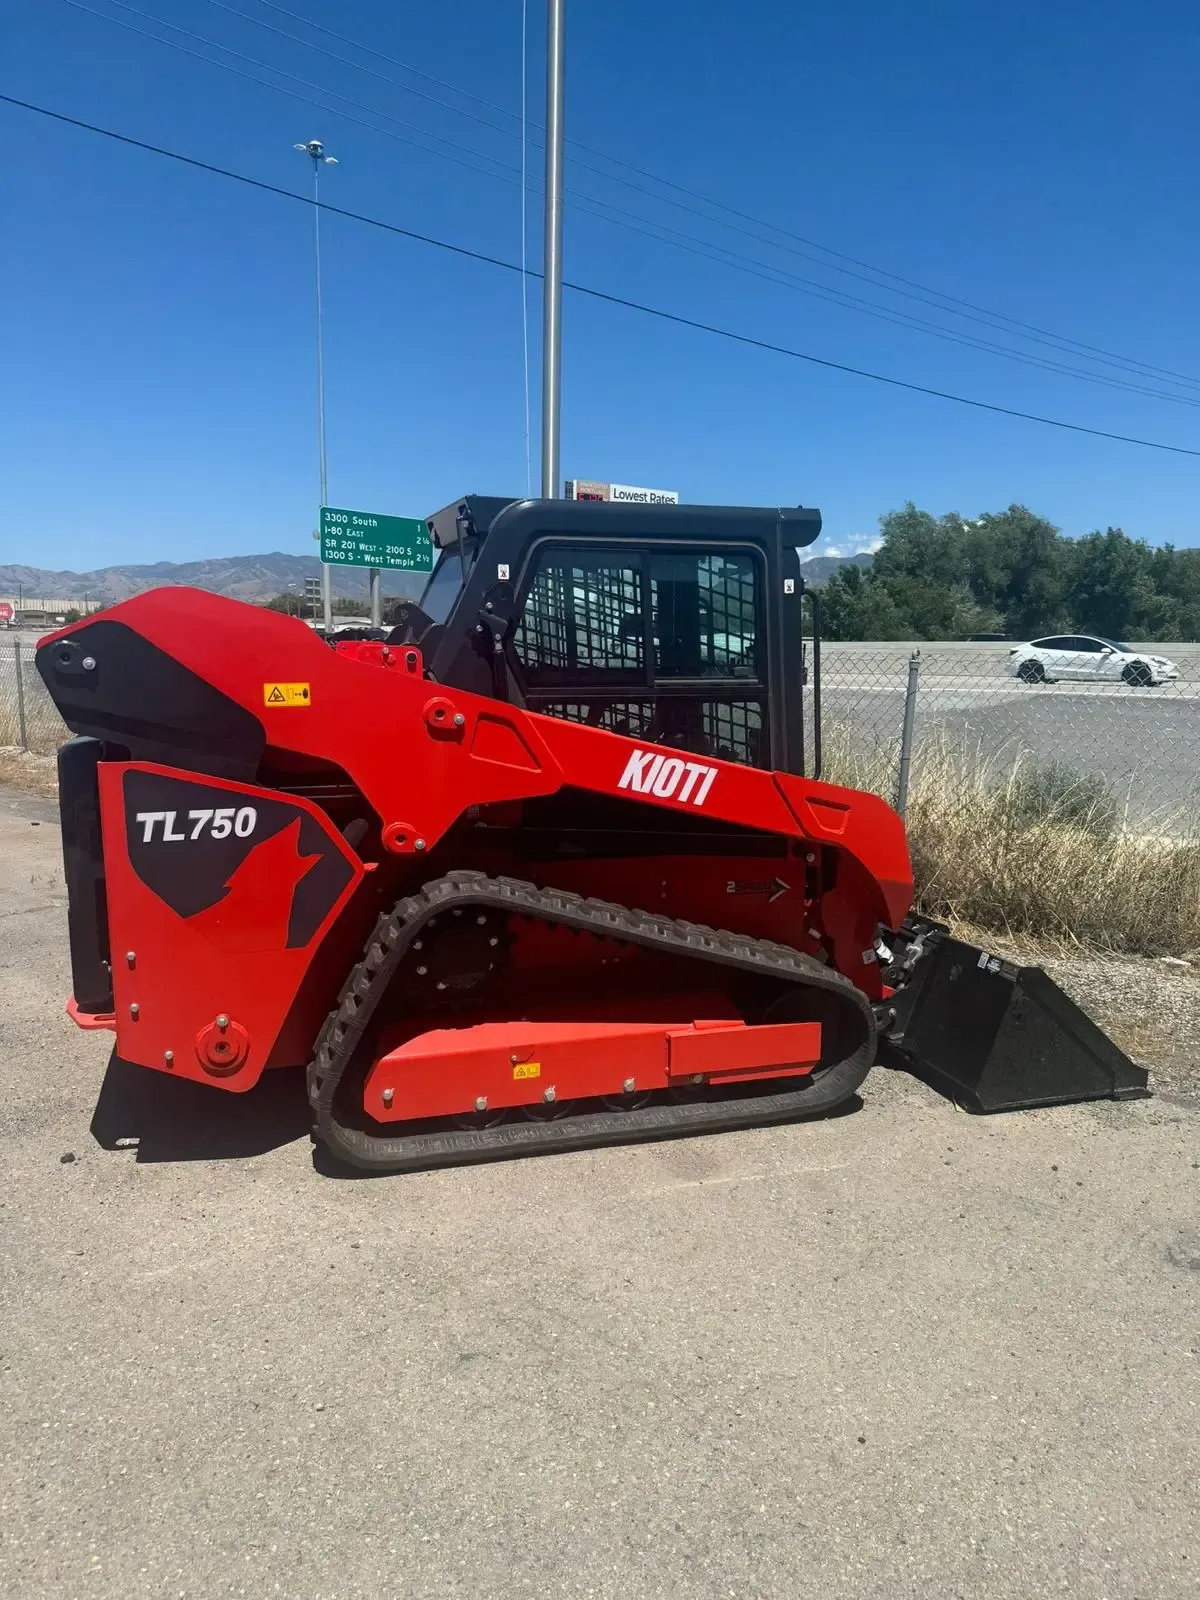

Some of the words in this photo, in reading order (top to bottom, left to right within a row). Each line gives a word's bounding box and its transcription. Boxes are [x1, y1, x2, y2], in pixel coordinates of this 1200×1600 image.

[613, 488, 648, 502] Lowest
[649, 493, 676, 504] Rates
[325, 512, 348, 523] 3300
[352, 516, 378, 527] South
[324, 525, 343, 536] I-80
[346, 529, 364, 538] EAST
[325, 538, 337, 548] SR
[341, 541, 356, 550] 201
[359, 543, 377, 552] WEST
[386, 545, 405, 555] 2100
[406, 547, 412, 556] S
[325, 550, 346, 560] 1300
[347, 552, 354, 561] S
[364, 554, 384, 564] West
[386, 556, 415, 567] Temple
[617, 748, 719, 806] KIOTI
[136, 806, 257, 843] TL750
